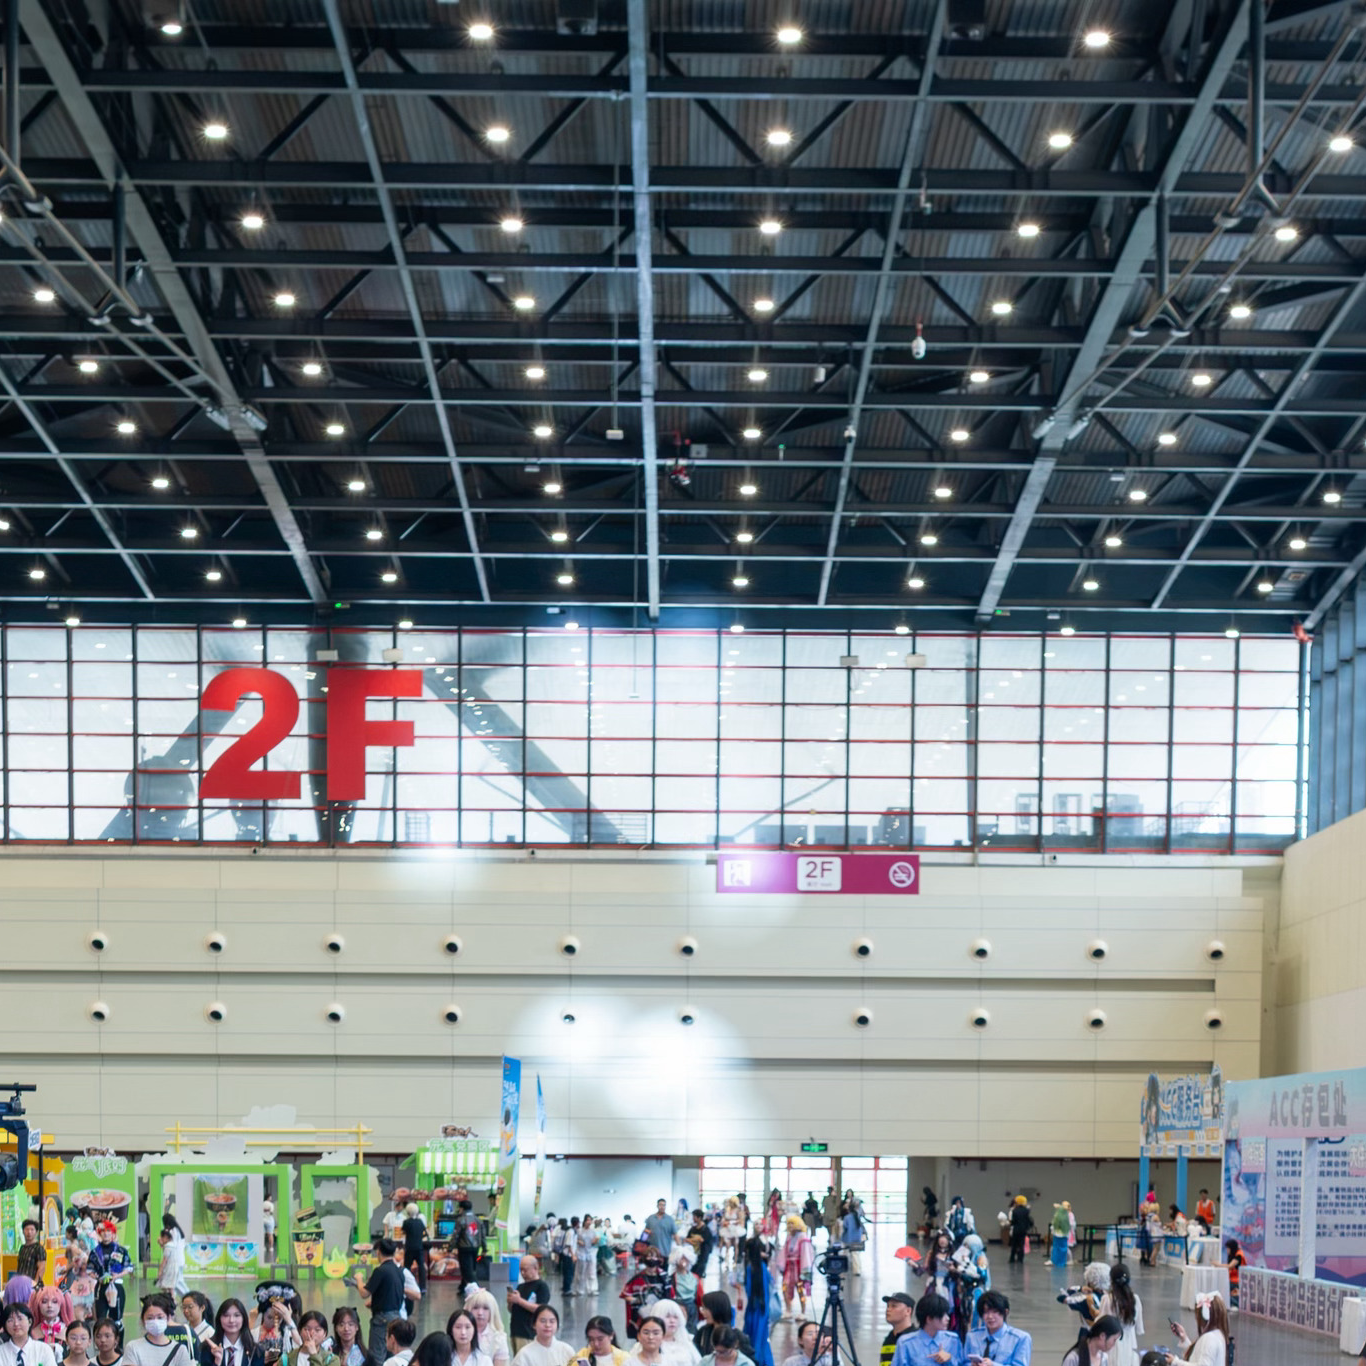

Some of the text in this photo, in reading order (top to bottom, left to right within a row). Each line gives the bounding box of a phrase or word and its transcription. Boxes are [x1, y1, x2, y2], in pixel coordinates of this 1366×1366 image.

[198, 667, 423, 801] 2F
[805, 861, 833, 878] 2F
[1268, 1080, 1348, 1128] ACC存包处
